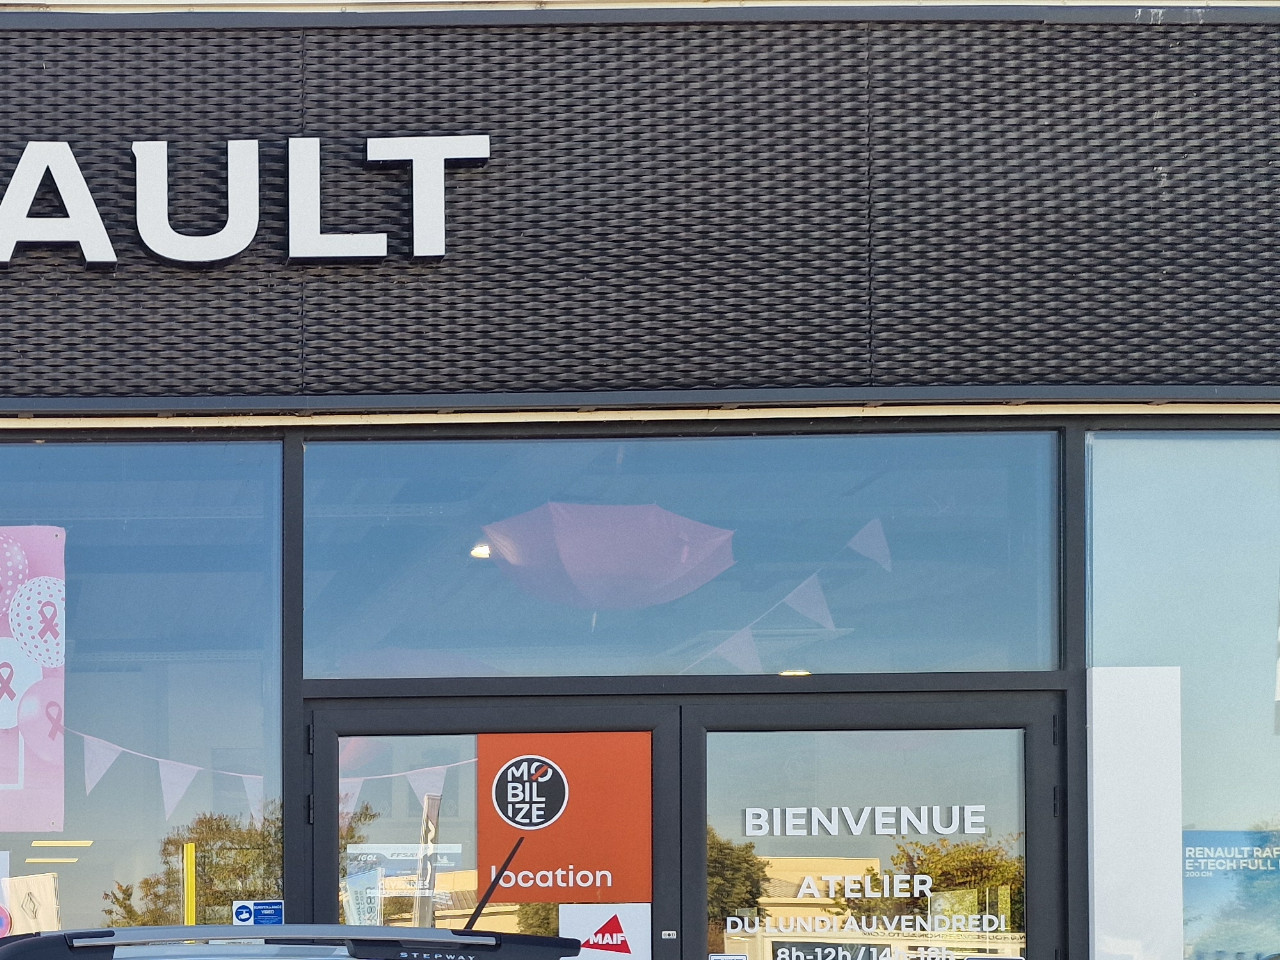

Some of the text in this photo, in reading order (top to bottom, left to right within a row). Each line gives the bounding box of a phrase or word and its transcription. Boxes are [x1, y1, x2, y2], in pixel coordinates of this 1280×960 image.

[744, 804, 987, 837] BIENVENUE
[1185, 846, 1251, 859] RENAULT
[1185, 858, 1276, 871] E-TECH FULL
[490, 865, 613, 888] location
[797, 874, 934, 899] ATELIER
[725, 914, 1007, 934] DU LUNDI AU VENDREDI
[589, 932, 627, 945] MAIF
[399, 952, 476, 960] STEPWAY
